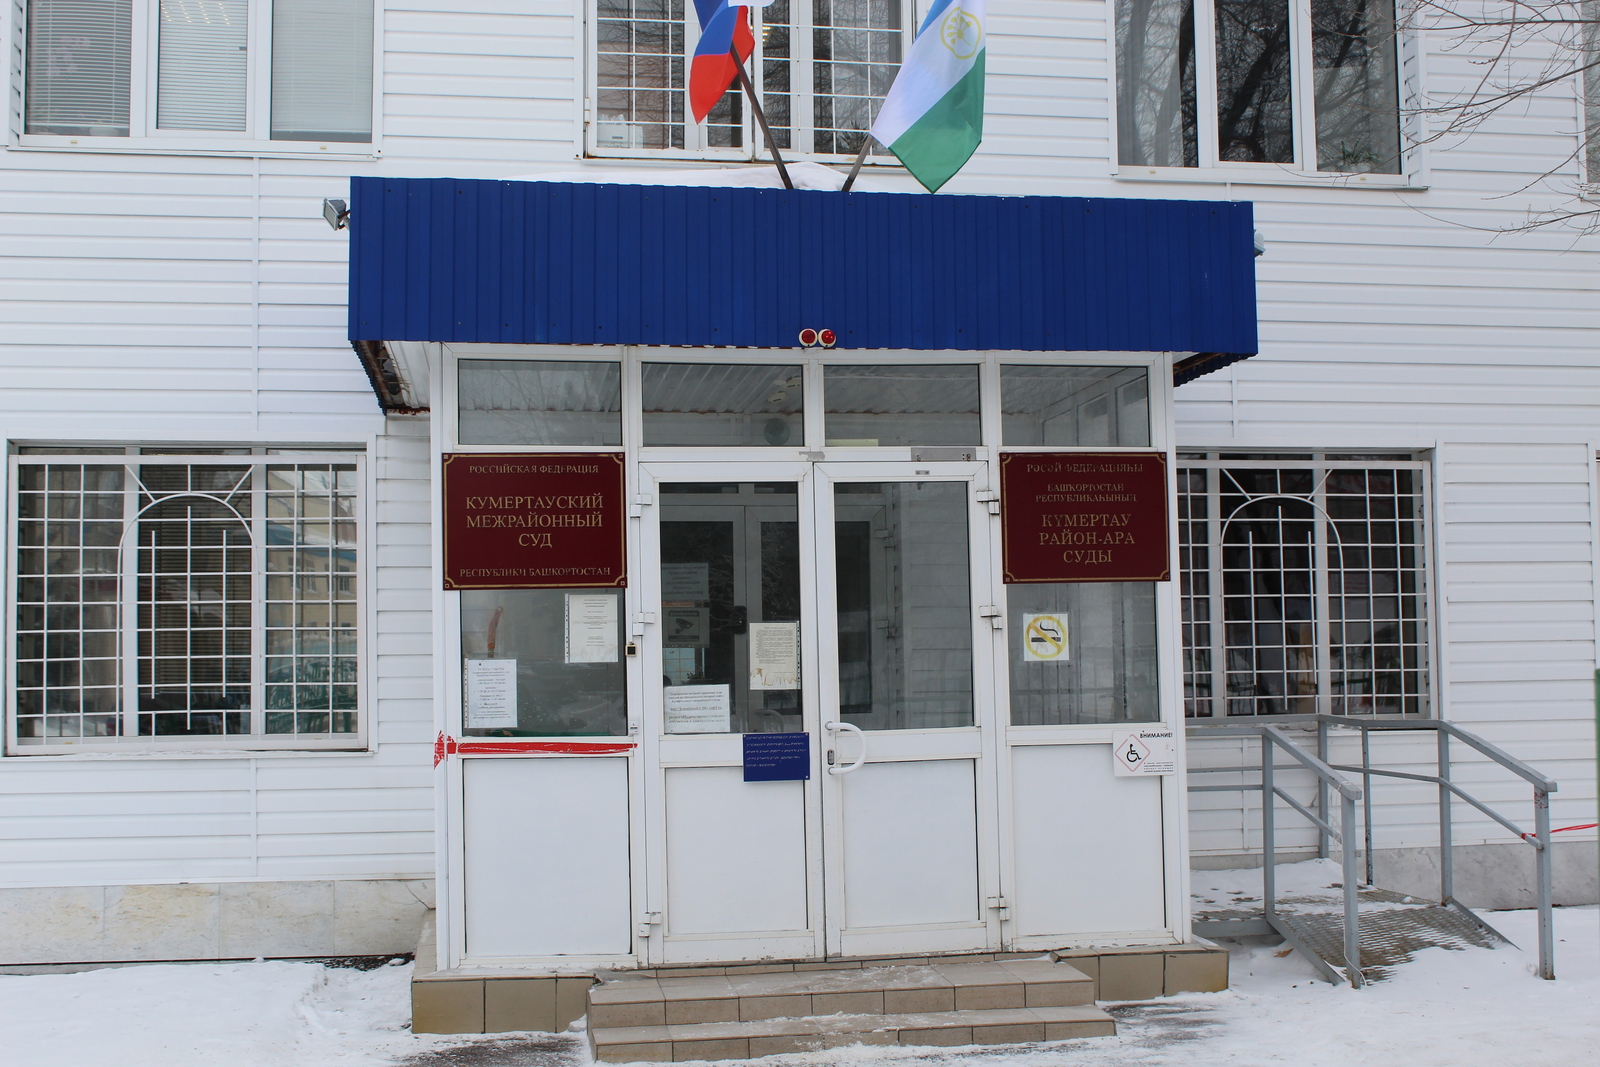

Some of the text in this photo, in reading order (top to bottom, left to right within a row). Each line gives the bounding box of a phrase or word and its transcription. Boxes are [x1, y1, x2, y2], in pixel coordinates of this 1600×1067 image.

[469, 464, 537, 474] РОССИЙСКАЯ
[465, 493, 604, 510] КУМЕРТАУСКИЙ
[466, 511, 603, 528] МЕЖРАЙОННЫЙ
[518, 533, 553, 549] СУД
[1039, 529, 1136, 545] РАЙОН-АРА
[1063, 550, 1113, 565] СУДЫ
[459, 567, 611, 578] РЕСПУБЛИКИ БАШКОРТОСТАН
